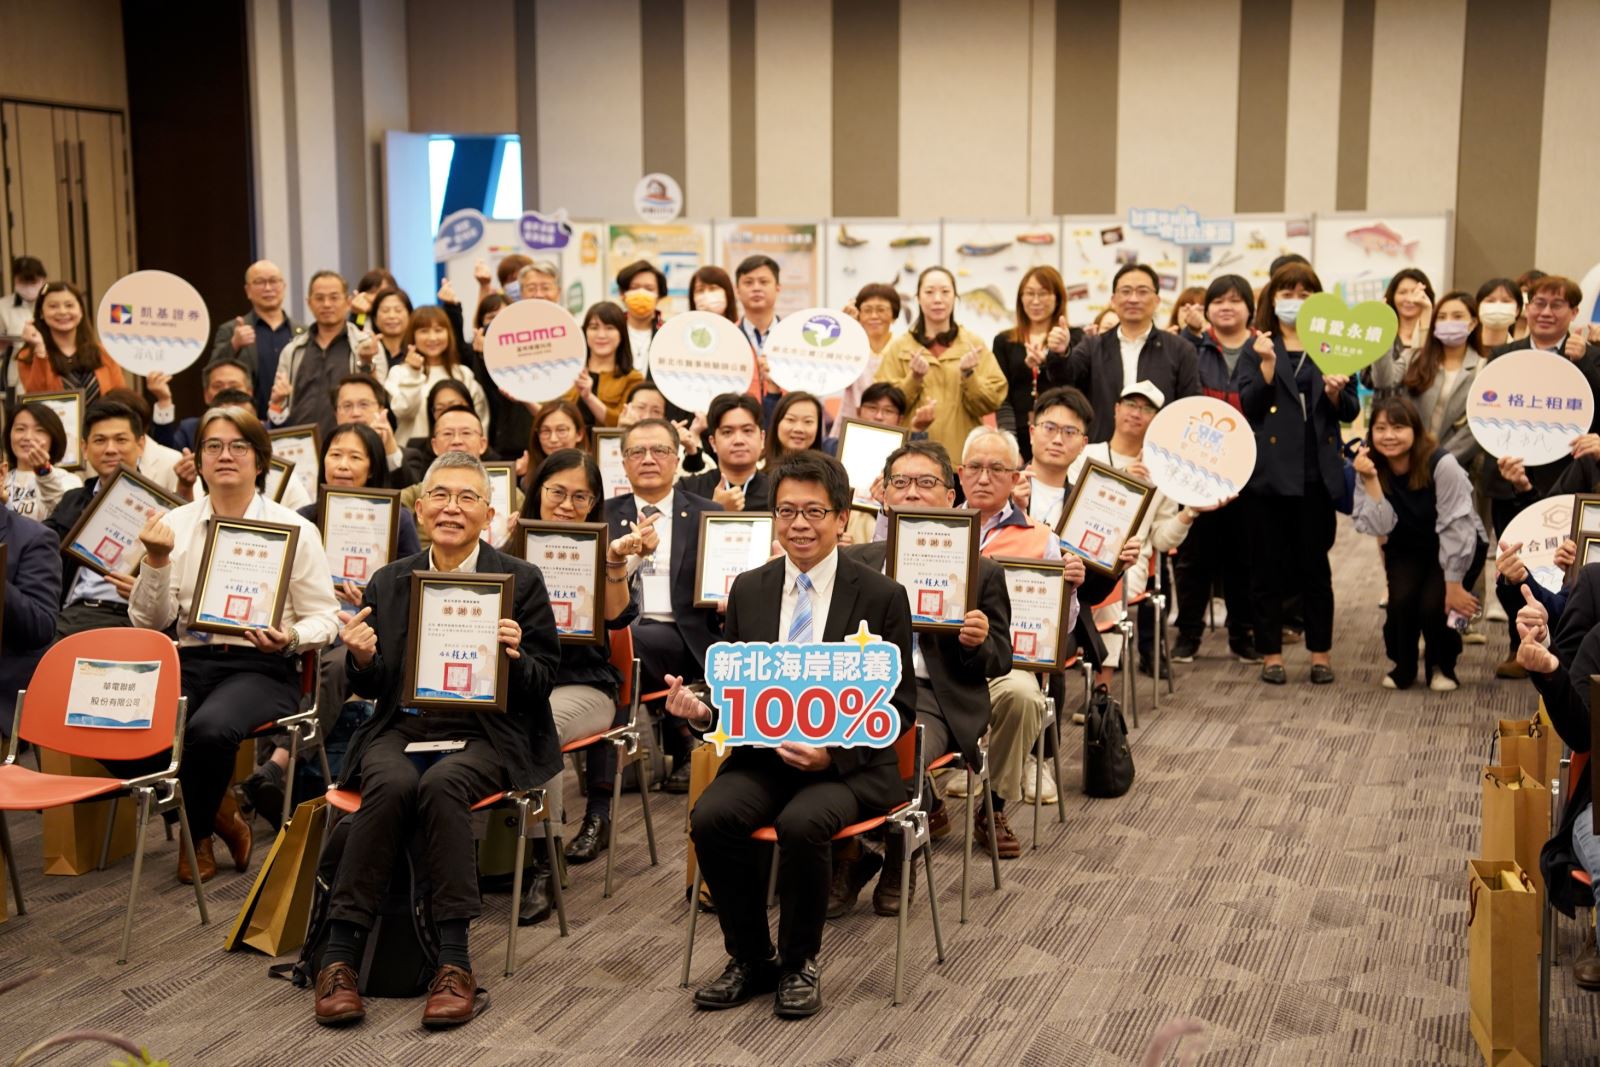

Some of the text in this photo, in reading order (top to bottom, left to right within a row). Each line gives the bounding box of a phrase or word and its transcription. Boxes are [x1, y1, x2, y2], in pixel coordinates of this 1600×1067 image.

[140, 306, 200, 321] 凱基證券
[498, 325, 567, 346] momo
[1309, 316, 1383, 343] 讓愛永續
[1507, 393, 1583, 411] 格上租車
[713, 650, 892, 682] 新北海岸認養
[91, 697, 141, 707] 股份有限公司
[723, 686, 892, 740] 100%
